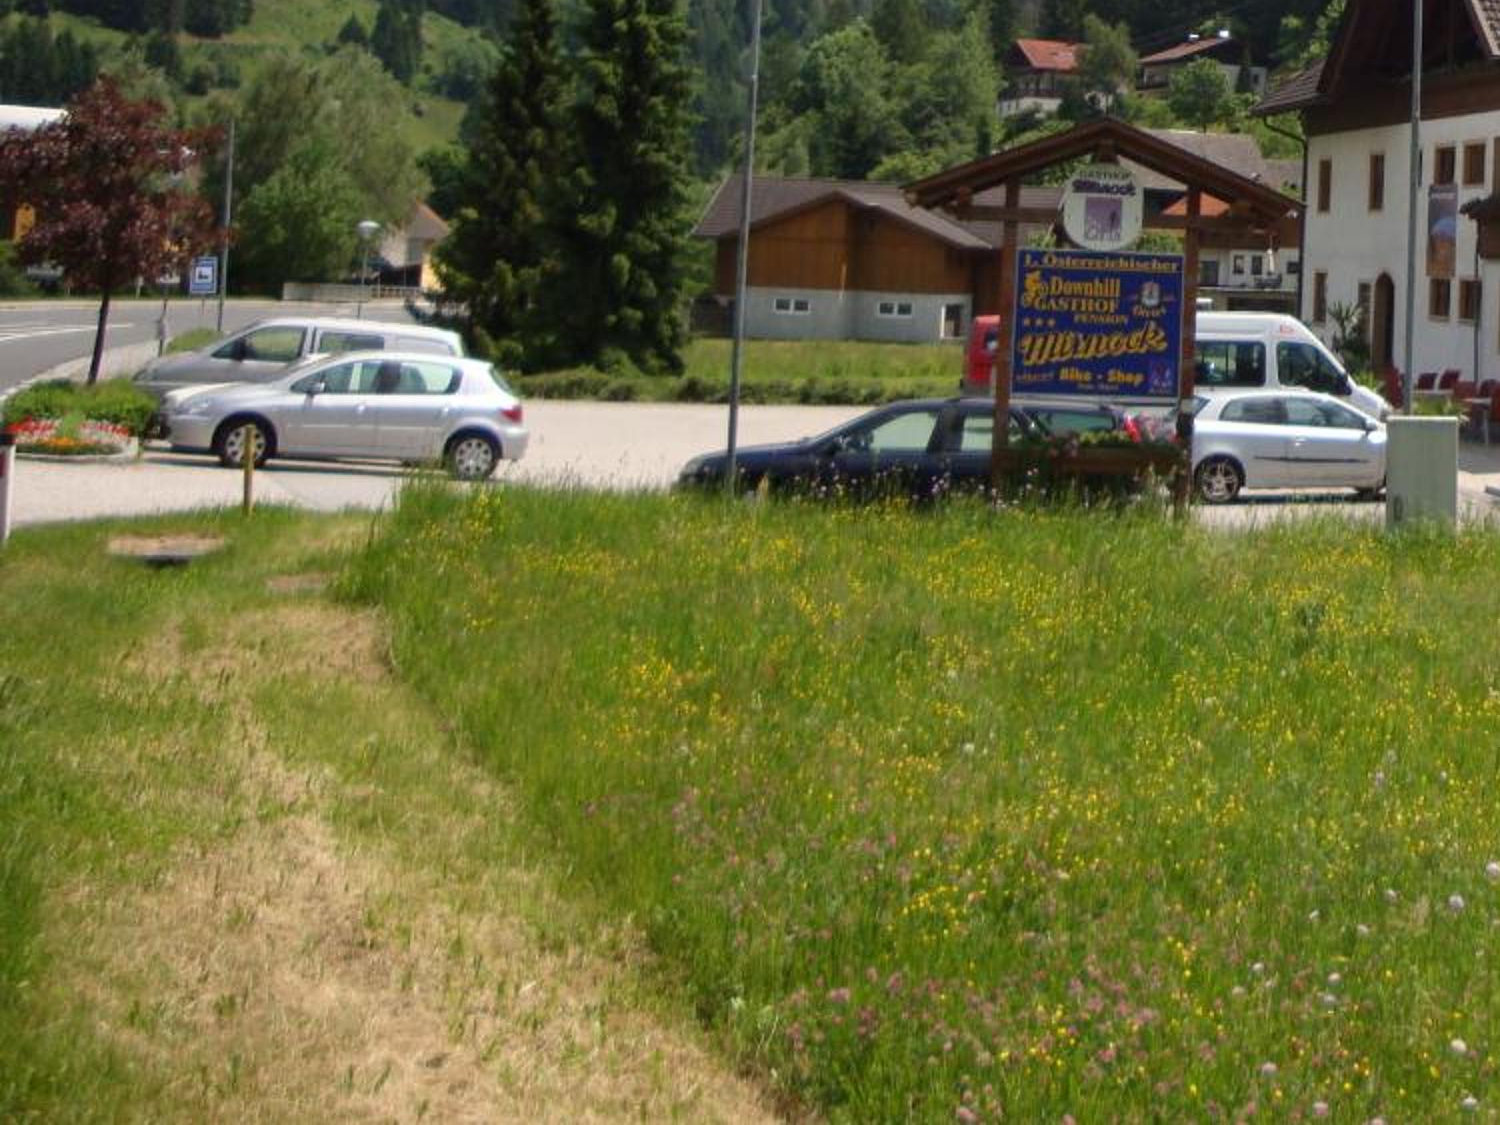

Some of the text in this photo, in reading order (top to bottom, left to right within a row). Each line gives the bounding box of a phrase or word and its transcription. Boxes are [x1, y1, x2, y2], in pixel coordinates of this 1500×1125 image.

[1050, 276, 1120, 298] Downhill
[1034, 297, 1120, 314] GASTHOF
[1073, 313, 1128, 325] PENSION
[1059, 367, 1092, 382] Bike
[1107, 368, 1144, 386] Shop
